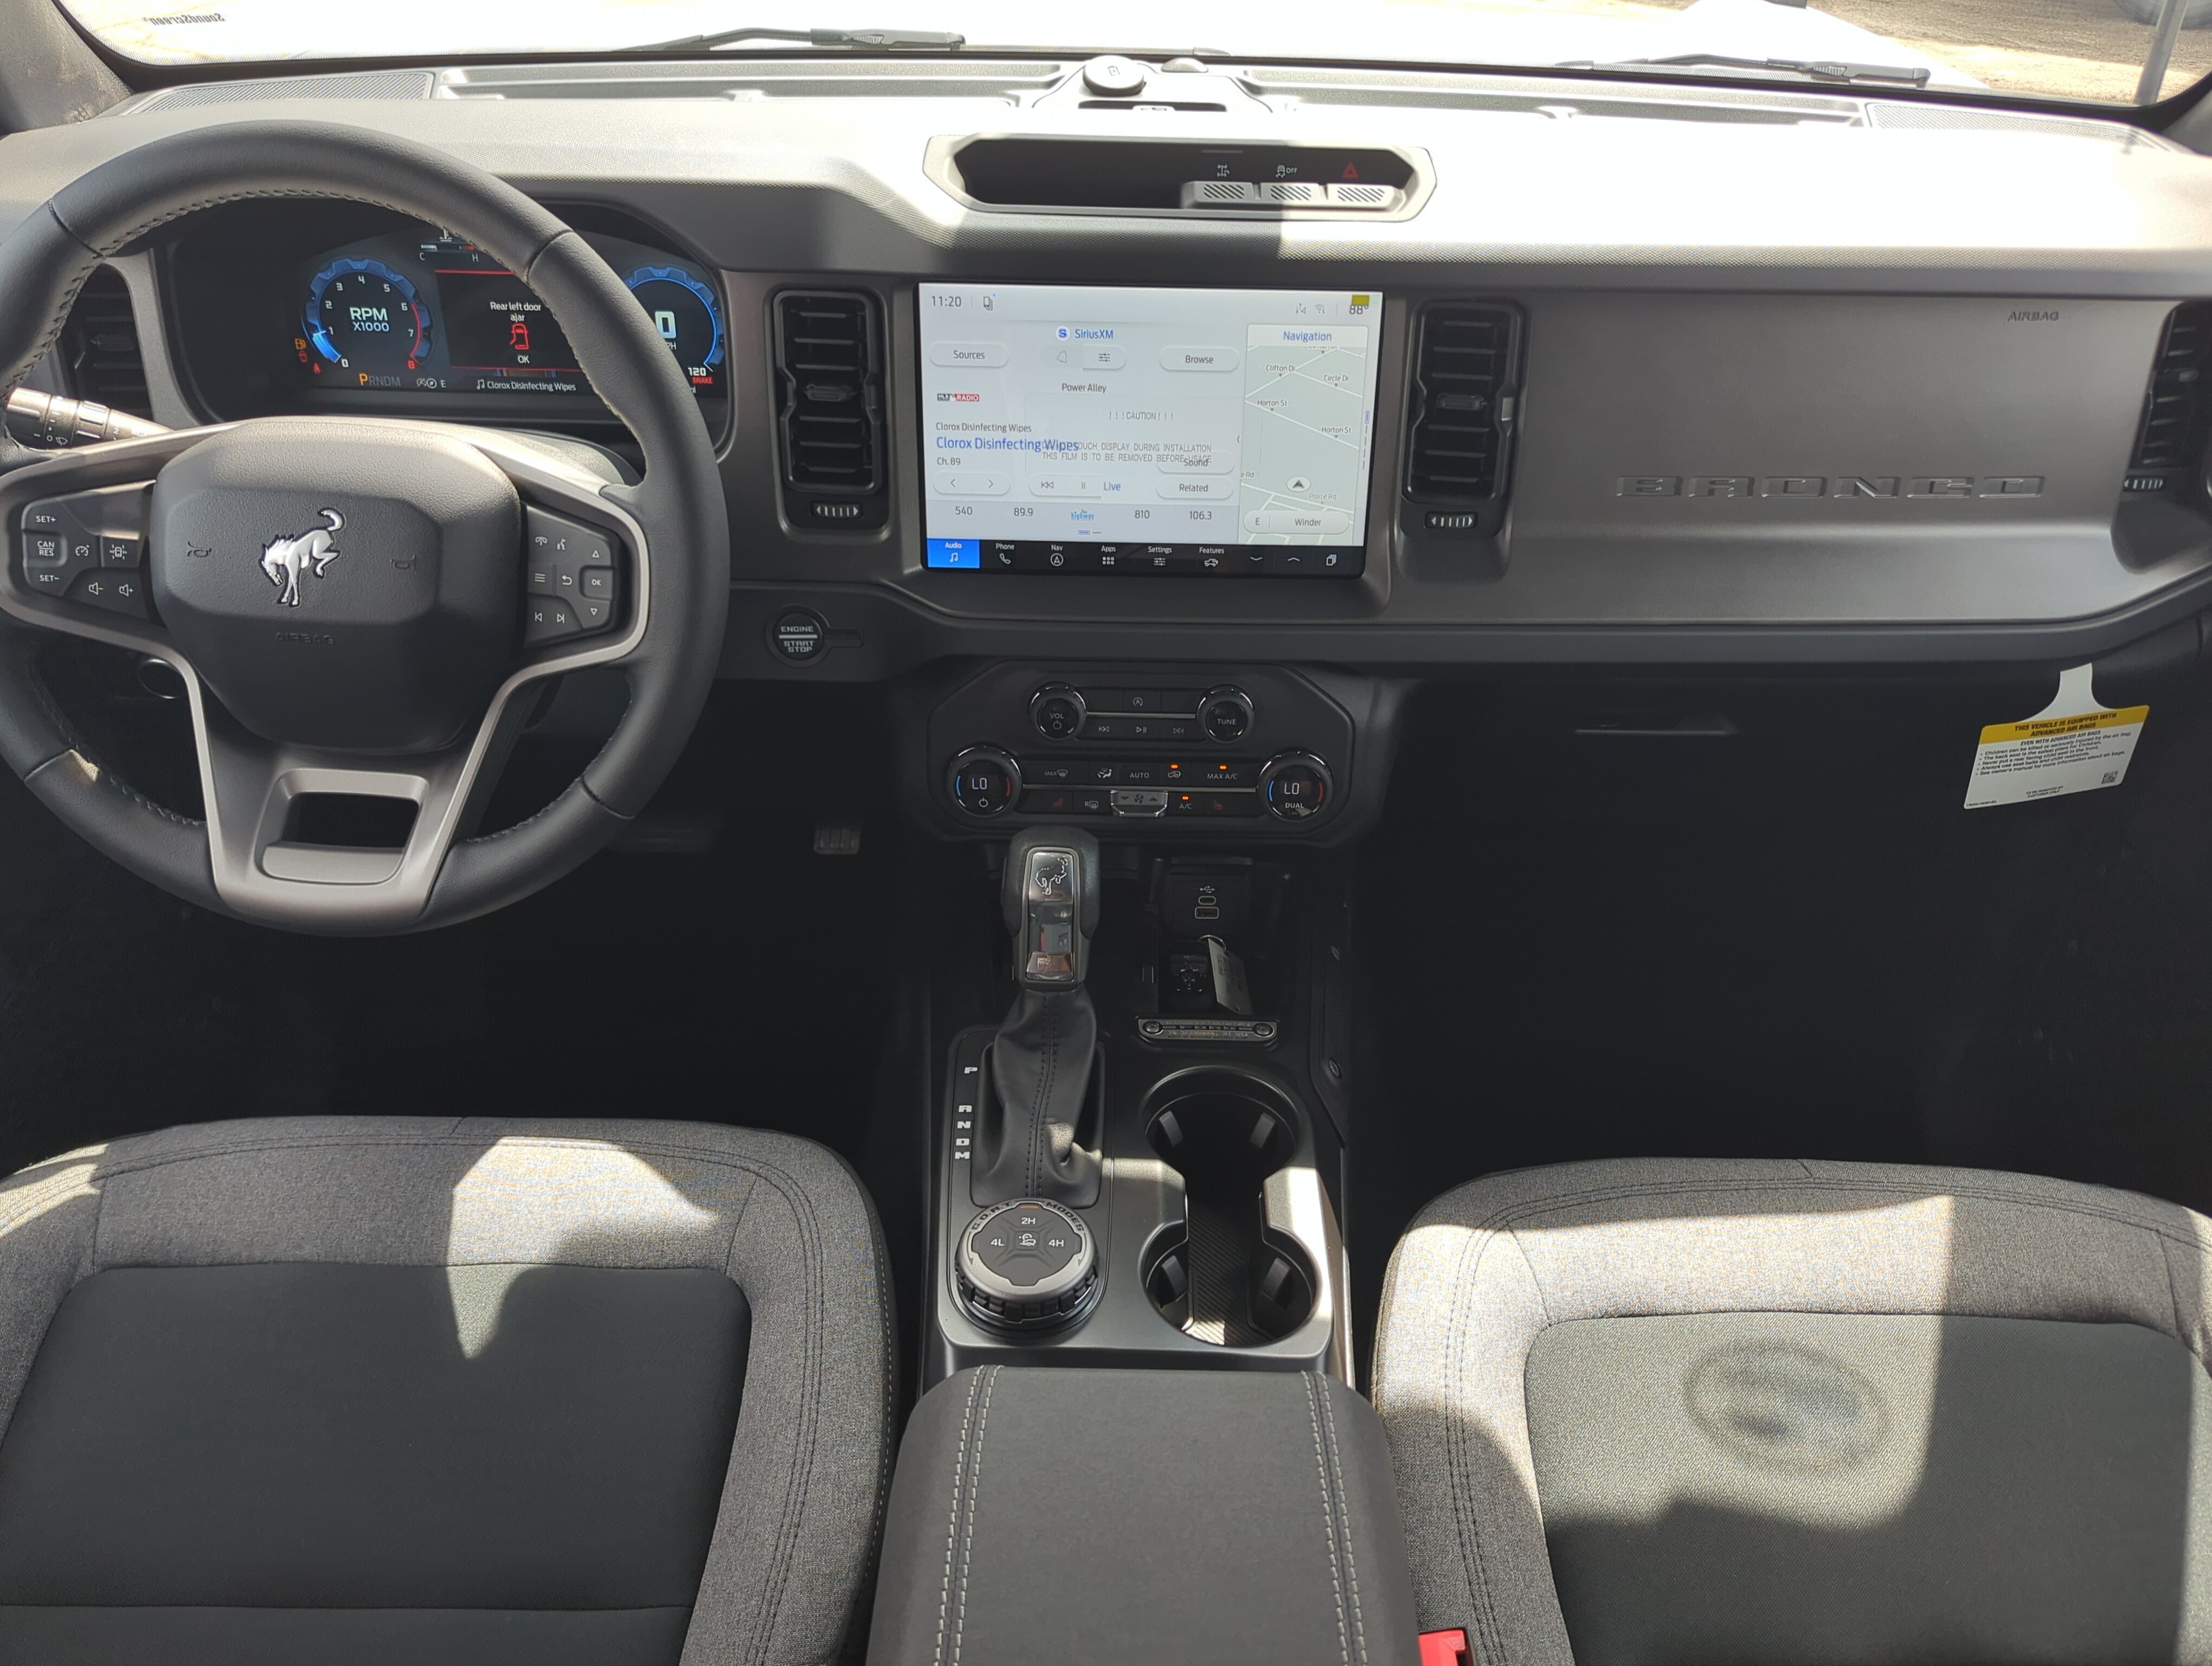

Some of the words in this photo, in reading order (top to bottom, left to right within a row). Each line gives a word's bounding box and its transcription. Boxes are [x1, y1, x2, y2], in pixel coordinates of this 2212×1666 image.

[419, 253, 425, 261] C
[358, 275, 365, 284] 4
[337, 283, 343, 291] 3
[383, 284, 390, 292] 5
[325, 301, 332, 309] 2
[931, 296, 962, 307] 11:20
[401, 303, 408, 311] 6
[490, 302, 507, 311] Rear
[509, 302, 523, 311] left
[524, 303, 541, 311] door
[350, 307, 388, 321] RPM
[511, 313, 525, 322] ajar
[2007, 311, 2059, 321] AIRBAG
[353, 322, 390, 332] X1000
[655, 311, 677, 338] 0
[329, 326, 334, 335] 1
[1075, 329, 1114, 339] SiriusXM
[1283, 331, 1332, 343] Navigation
[954, 350, 985, 360] Sources
[1185, 355, 1214, 364] Browse
[342, 358, 349, 368] 0
[518, 356, 530, 364] OK
[687, 367, 706, 376] 120
[1323, 374, 1341, 382] Circle
[487, 381, 510, 390] Clorox
[511, 382, 554, 392] Disinfecting
[554, 383, 576, 392] Wipes
[1062, 383, 1085, 392] Power
[1087, 383, 1107, 394] Alley
[936, 422, 960, 432] Clorox
[961, 423, 1007, 433] Disinfecting
[1008, 424, 1032, 433] Wipes
[936, 437, 972, 450] Clorox
[975, 438, 1041, 453] Disinfecting
[1044, 439, 1079, 452] Wipes
[1102, 443, 1130, 451] DISPLAY
[1134, 443, 1160, 452] DURING
[1163, 444, 1212, 453] INSTALLATION
[950, 458, 961, 466] 89
[1043, 452, 1057, 460] THIS
[1062, 452, 1077, 460] FILM
[1092, 453, 1101, 461] TO
[1105, 453, 1115, 462] BE
[1118, 453, 1153, 462] REMOVED
[1157, 454, 1184, 463] BEFORE
[1184, 458, 1208, 467] Sound
[1104, 482, 1121, 491] Live
[1179, 483, 1208, 492] Related
[1616, 475, 2044, 498] BRONCO
[1309, 492, 1327, 501] Polite
[955, 507, 973, 516] 540
[1014, 508, 1033, 517] 89.9
[1134, 510, 1149, 520] 810
[1189, 510, 1212, 520] 106.3
[1071, 512, 1094, 521] highway
[1295, 518, 1322, 527] Winder
[996, 543, 1015, 551] Phone
[1101, 545, 1116, 554] Apps
[1148, 546, 1172, 554] Settings
[2067, 715, 2098, 725] EQUIPPED
[2030, 728, 2065, 737] ADVANCED
[2050, 734, 2076, 742] ADVANCED
[972, 777, 987, 790] LO
[1284, 783, 1300, 796] LO
[956, 1138, 970, 1146] D
[1021, 1217, 1036, 1225] 2H
[1045, 1202, 1085, 1232] MODES
[991, 1238, 1005, 1247] 4L
[1049, 1239, 1064, 1247] 4H
